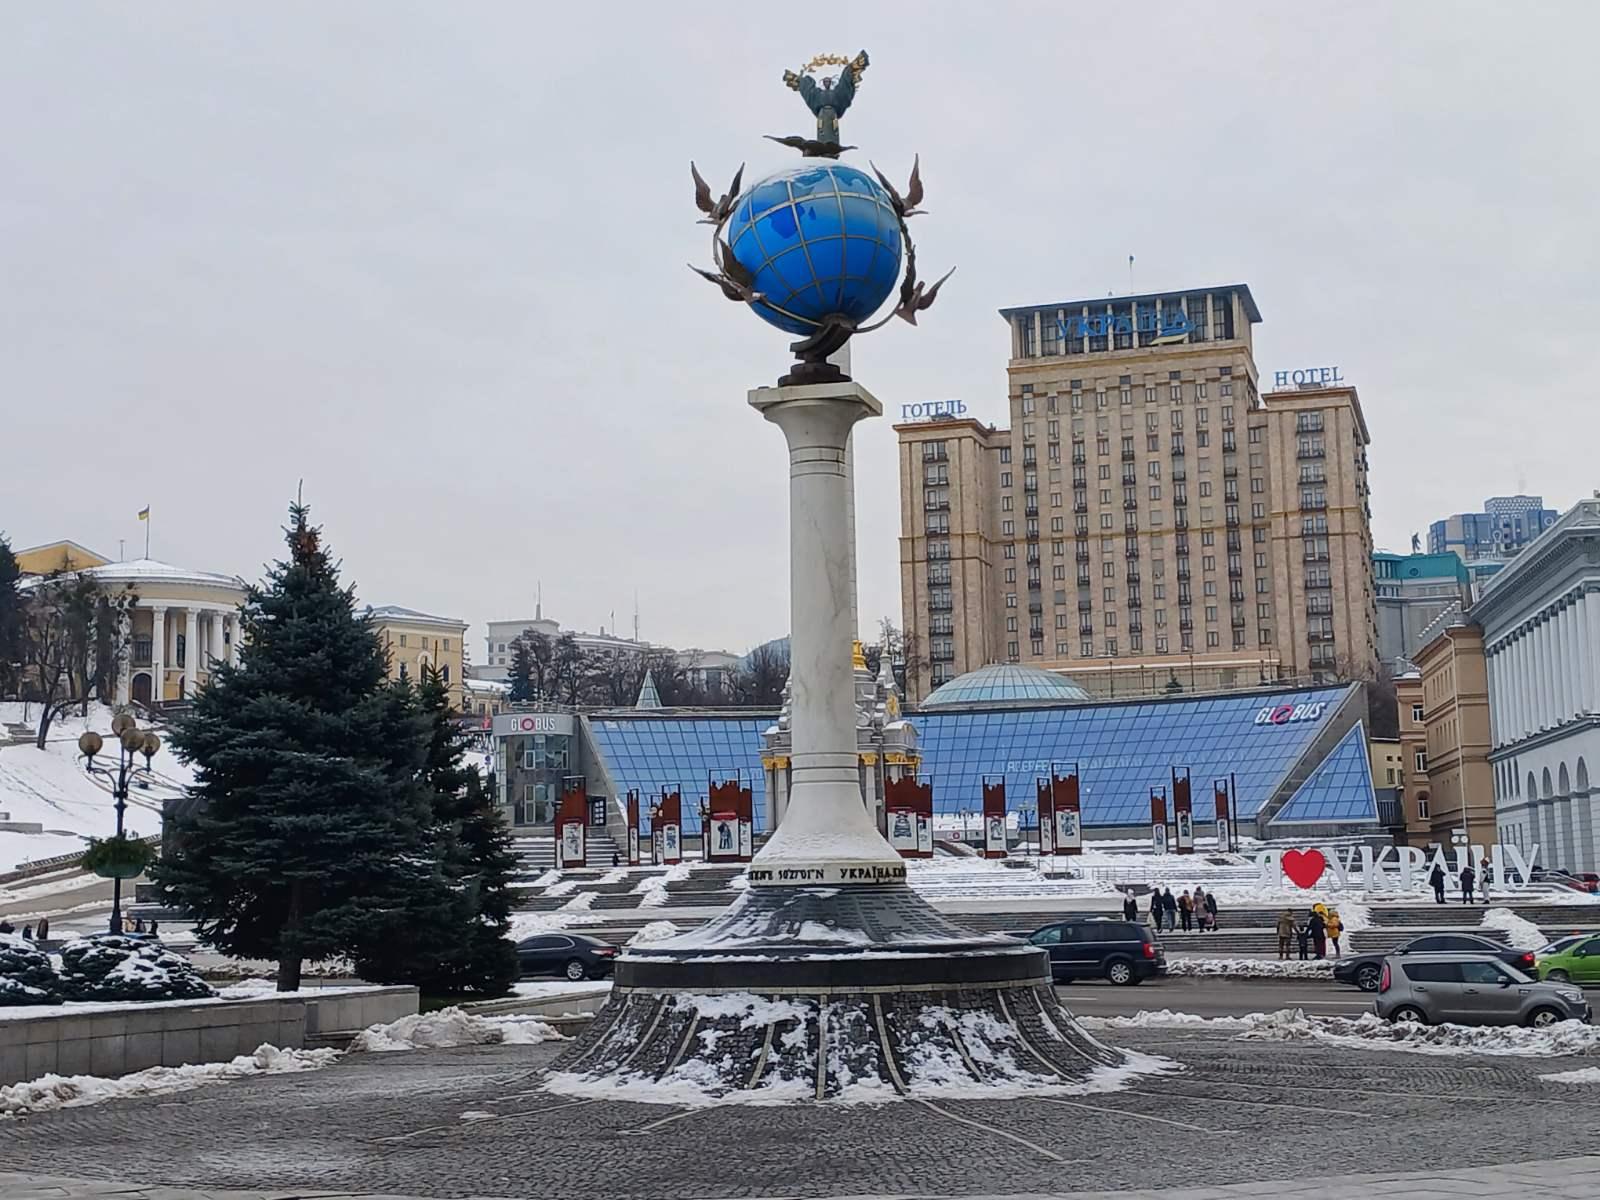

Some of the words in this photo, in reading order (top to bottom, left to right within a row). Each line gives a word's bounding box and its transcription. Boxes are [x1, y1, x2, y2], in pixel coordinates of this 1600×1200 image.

[1274, 366, 1344, 386] HOTEL
[902, 399, 967, 419] ГОТЕЛЬ
[1255, 702, 1325, 725] GLOBUS
[511, 717, 556, 732] GLOBUS
[1254, 848, 1283, 891] Я
[1320, 836, 1540, 892] УКРАЇНУ
